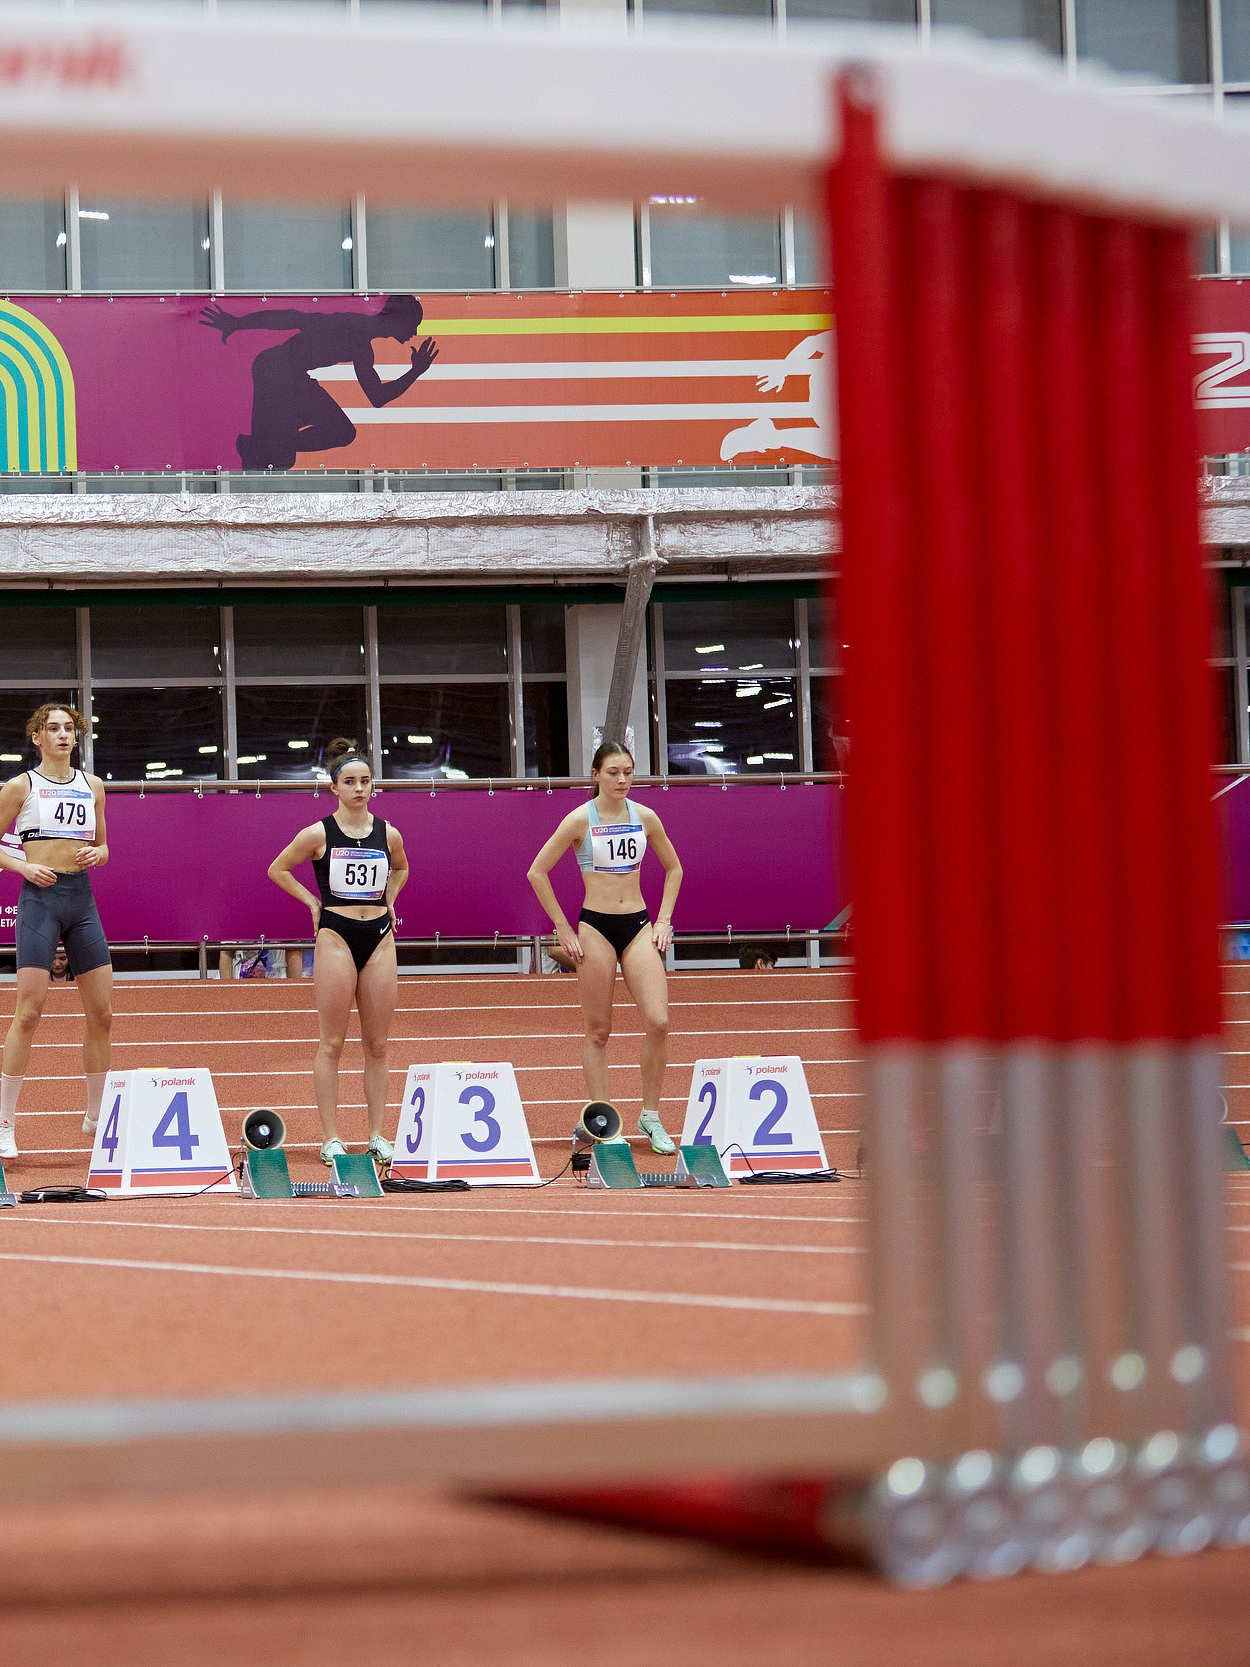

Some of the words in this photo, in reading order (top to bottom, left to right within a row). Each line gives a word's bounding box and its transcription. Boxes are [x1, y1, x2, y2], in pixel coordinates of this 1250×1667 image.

[54, 802, 87, 826] 479
[607, 838, 637, 860] 146
[345, 863, 377, 886] 531
[160, 1077, 196, 1088] polanik
[464, 1071, 499, 1081] polanik
[755, 1065, 789, 1076] polanik
[101, 1094, 122, 1163] 4
[152, 1091, 200, 1161] 4
[406, 1086, 426, 1154] 3
[458, 1085, 502, 1153] 3
[693, 1081, 717, 1146] 2
[748, 1079, 793, 1146] 2
